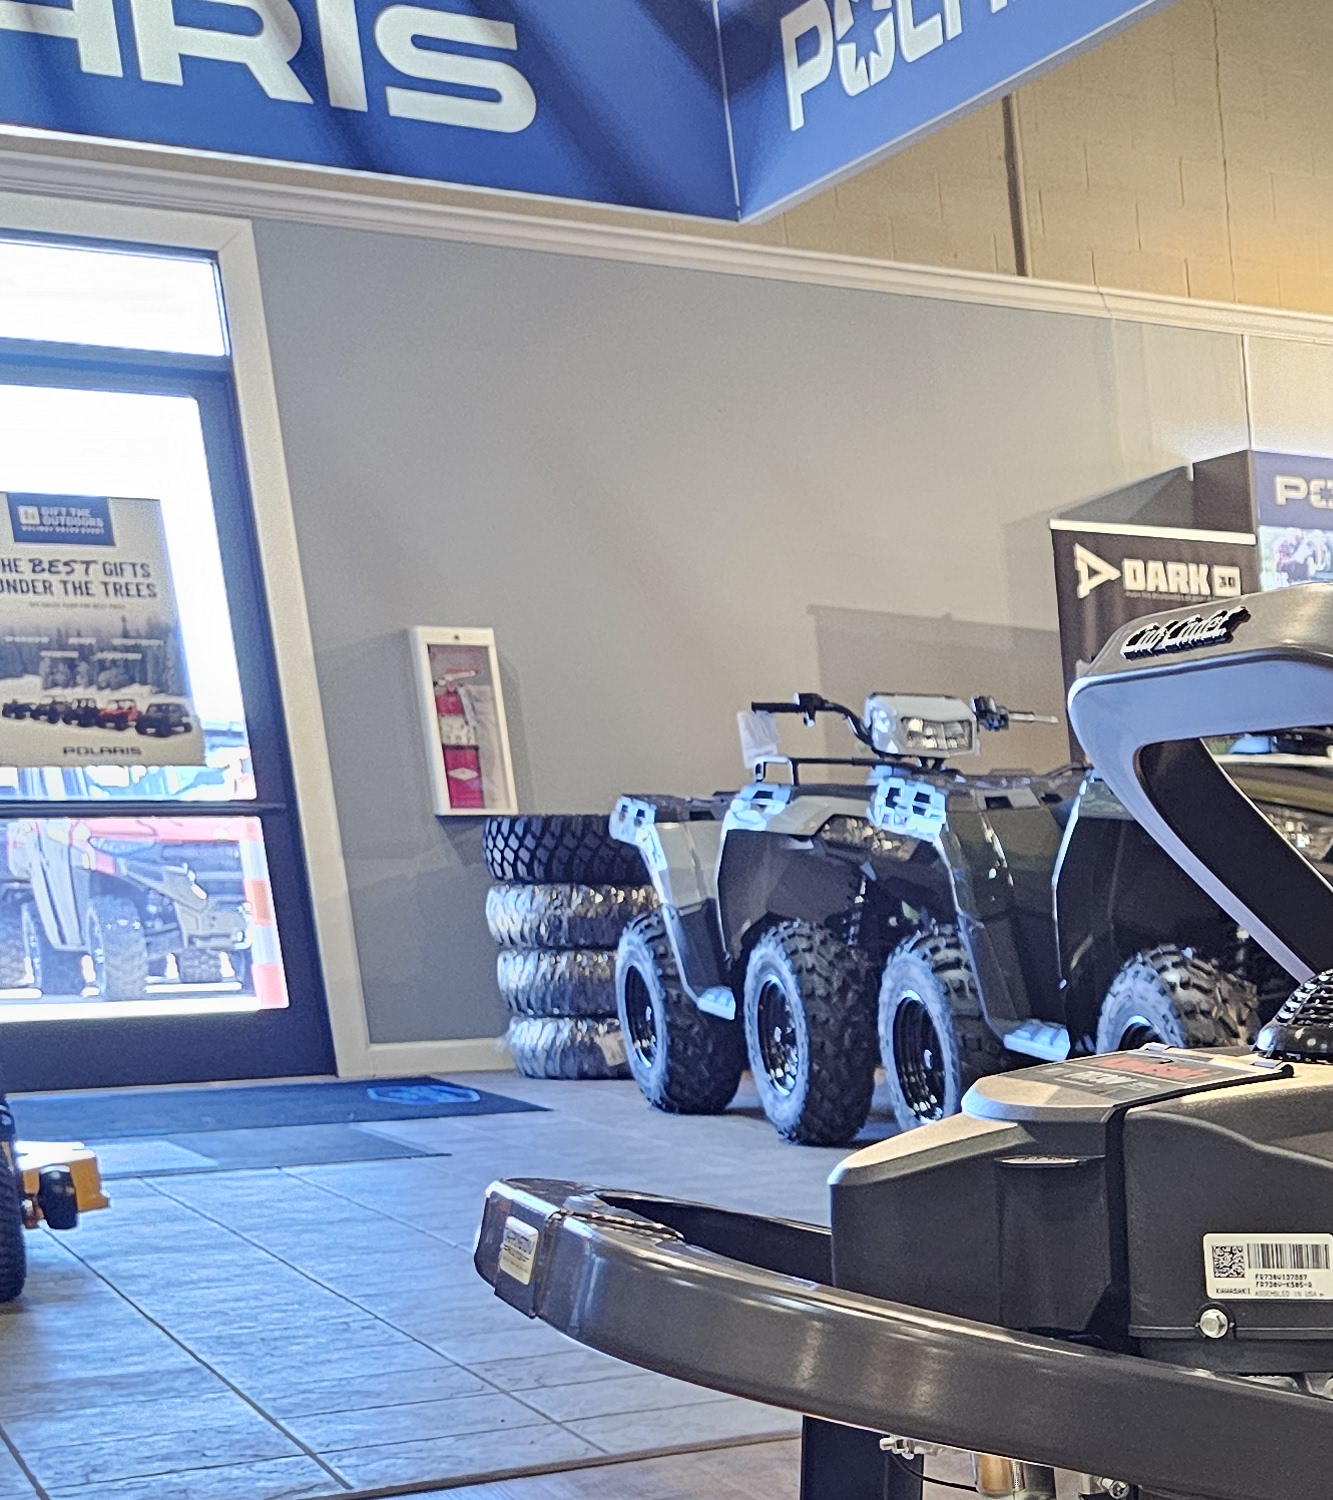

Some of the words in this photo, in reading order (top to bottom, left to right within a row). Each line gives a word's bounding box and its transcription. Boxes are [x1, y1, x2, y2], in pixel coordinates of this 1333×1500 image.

[781, 0, 1020, 131] POL
[0, 557, 23, 576] HE
[28, 557, 98, 576] BEST
[102, 561, 152, 578] GIFTS
[1121, 557, 1211, 596] DARK
[59, 579, 96, 597] THE
[101, 581, 158, 599] TREES
[62, 746, 142, 756] POLARIS
